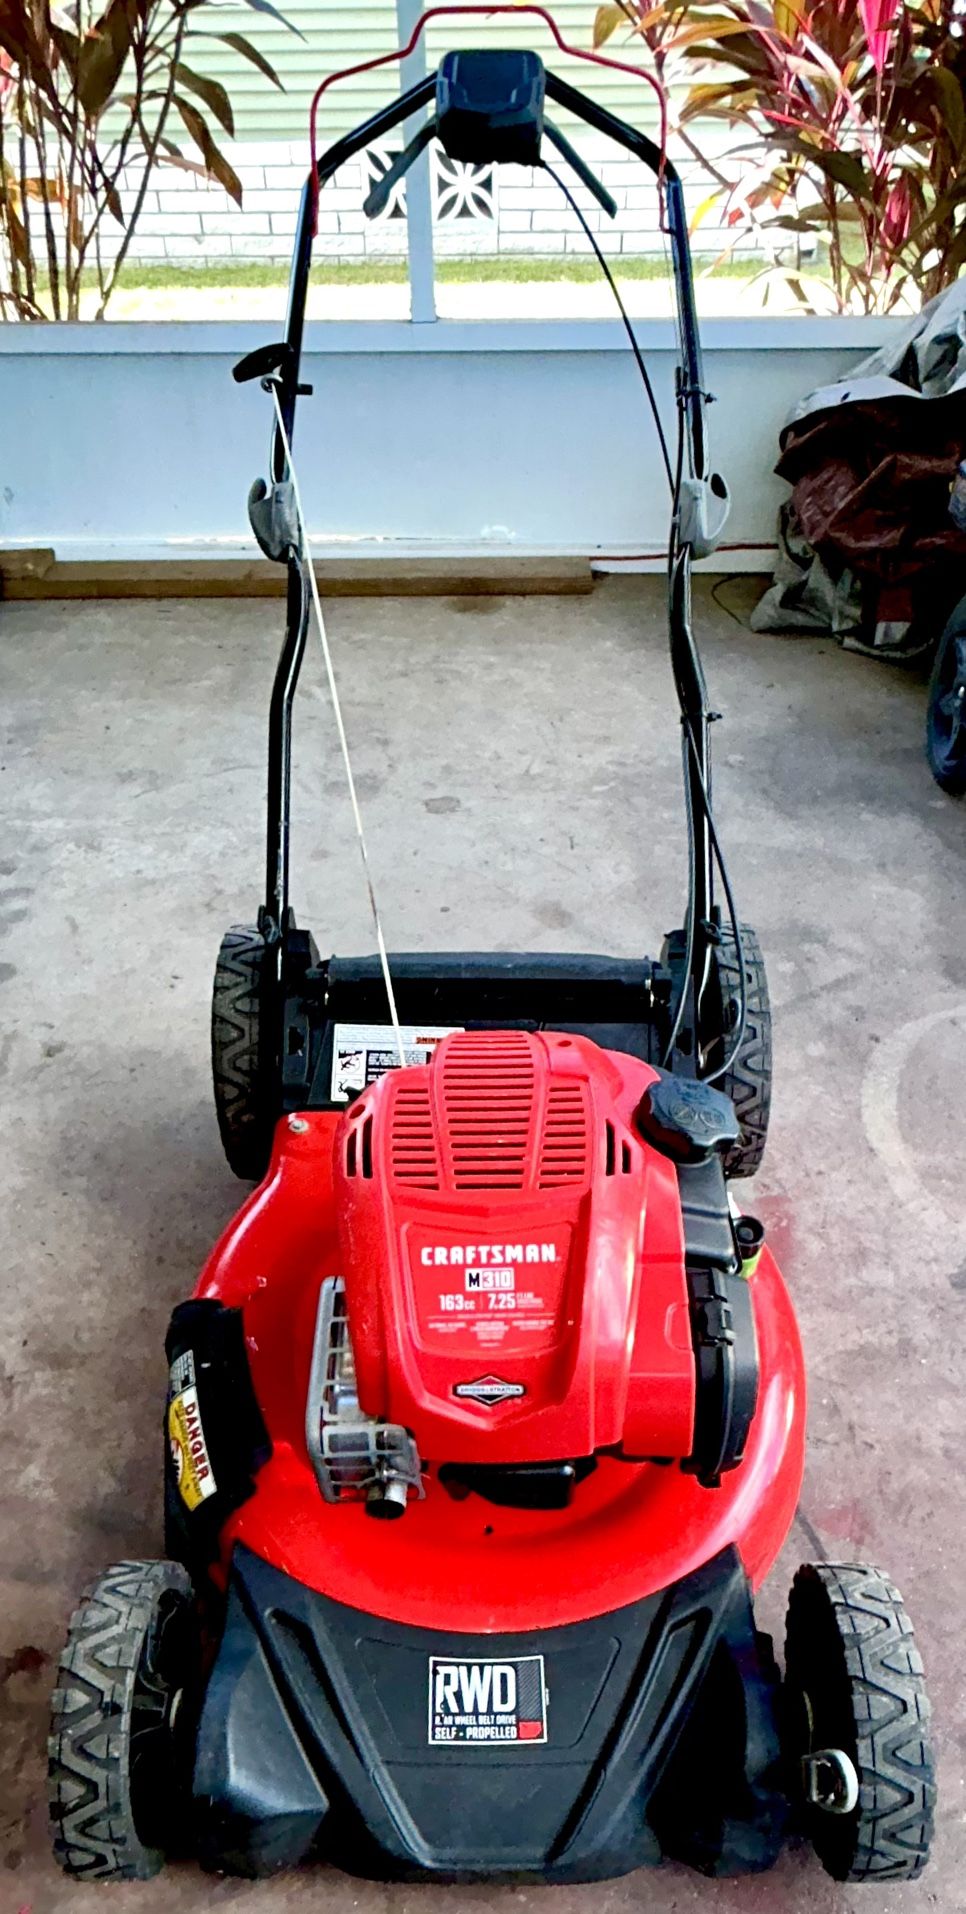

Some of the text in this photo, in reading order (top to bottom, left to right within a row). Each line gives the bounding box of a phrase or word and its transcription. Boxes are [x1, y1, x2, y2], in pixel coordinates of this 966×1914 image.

[421, 1243, 556, 1266] CRAFTSMAN
[438, 1292, 516, 1311] 163cc 7.25
[185, 1402, 209, 1480] DANGER
[435, 1665, 516, 1713] RWD
[454, 1715, 477, 1725] WHEEL
[496, 1714, 516, 1725] DRIVE
[435, 1727, 457, 1739] SELF
[466, 1726, 517, 1739] PROPELLED
